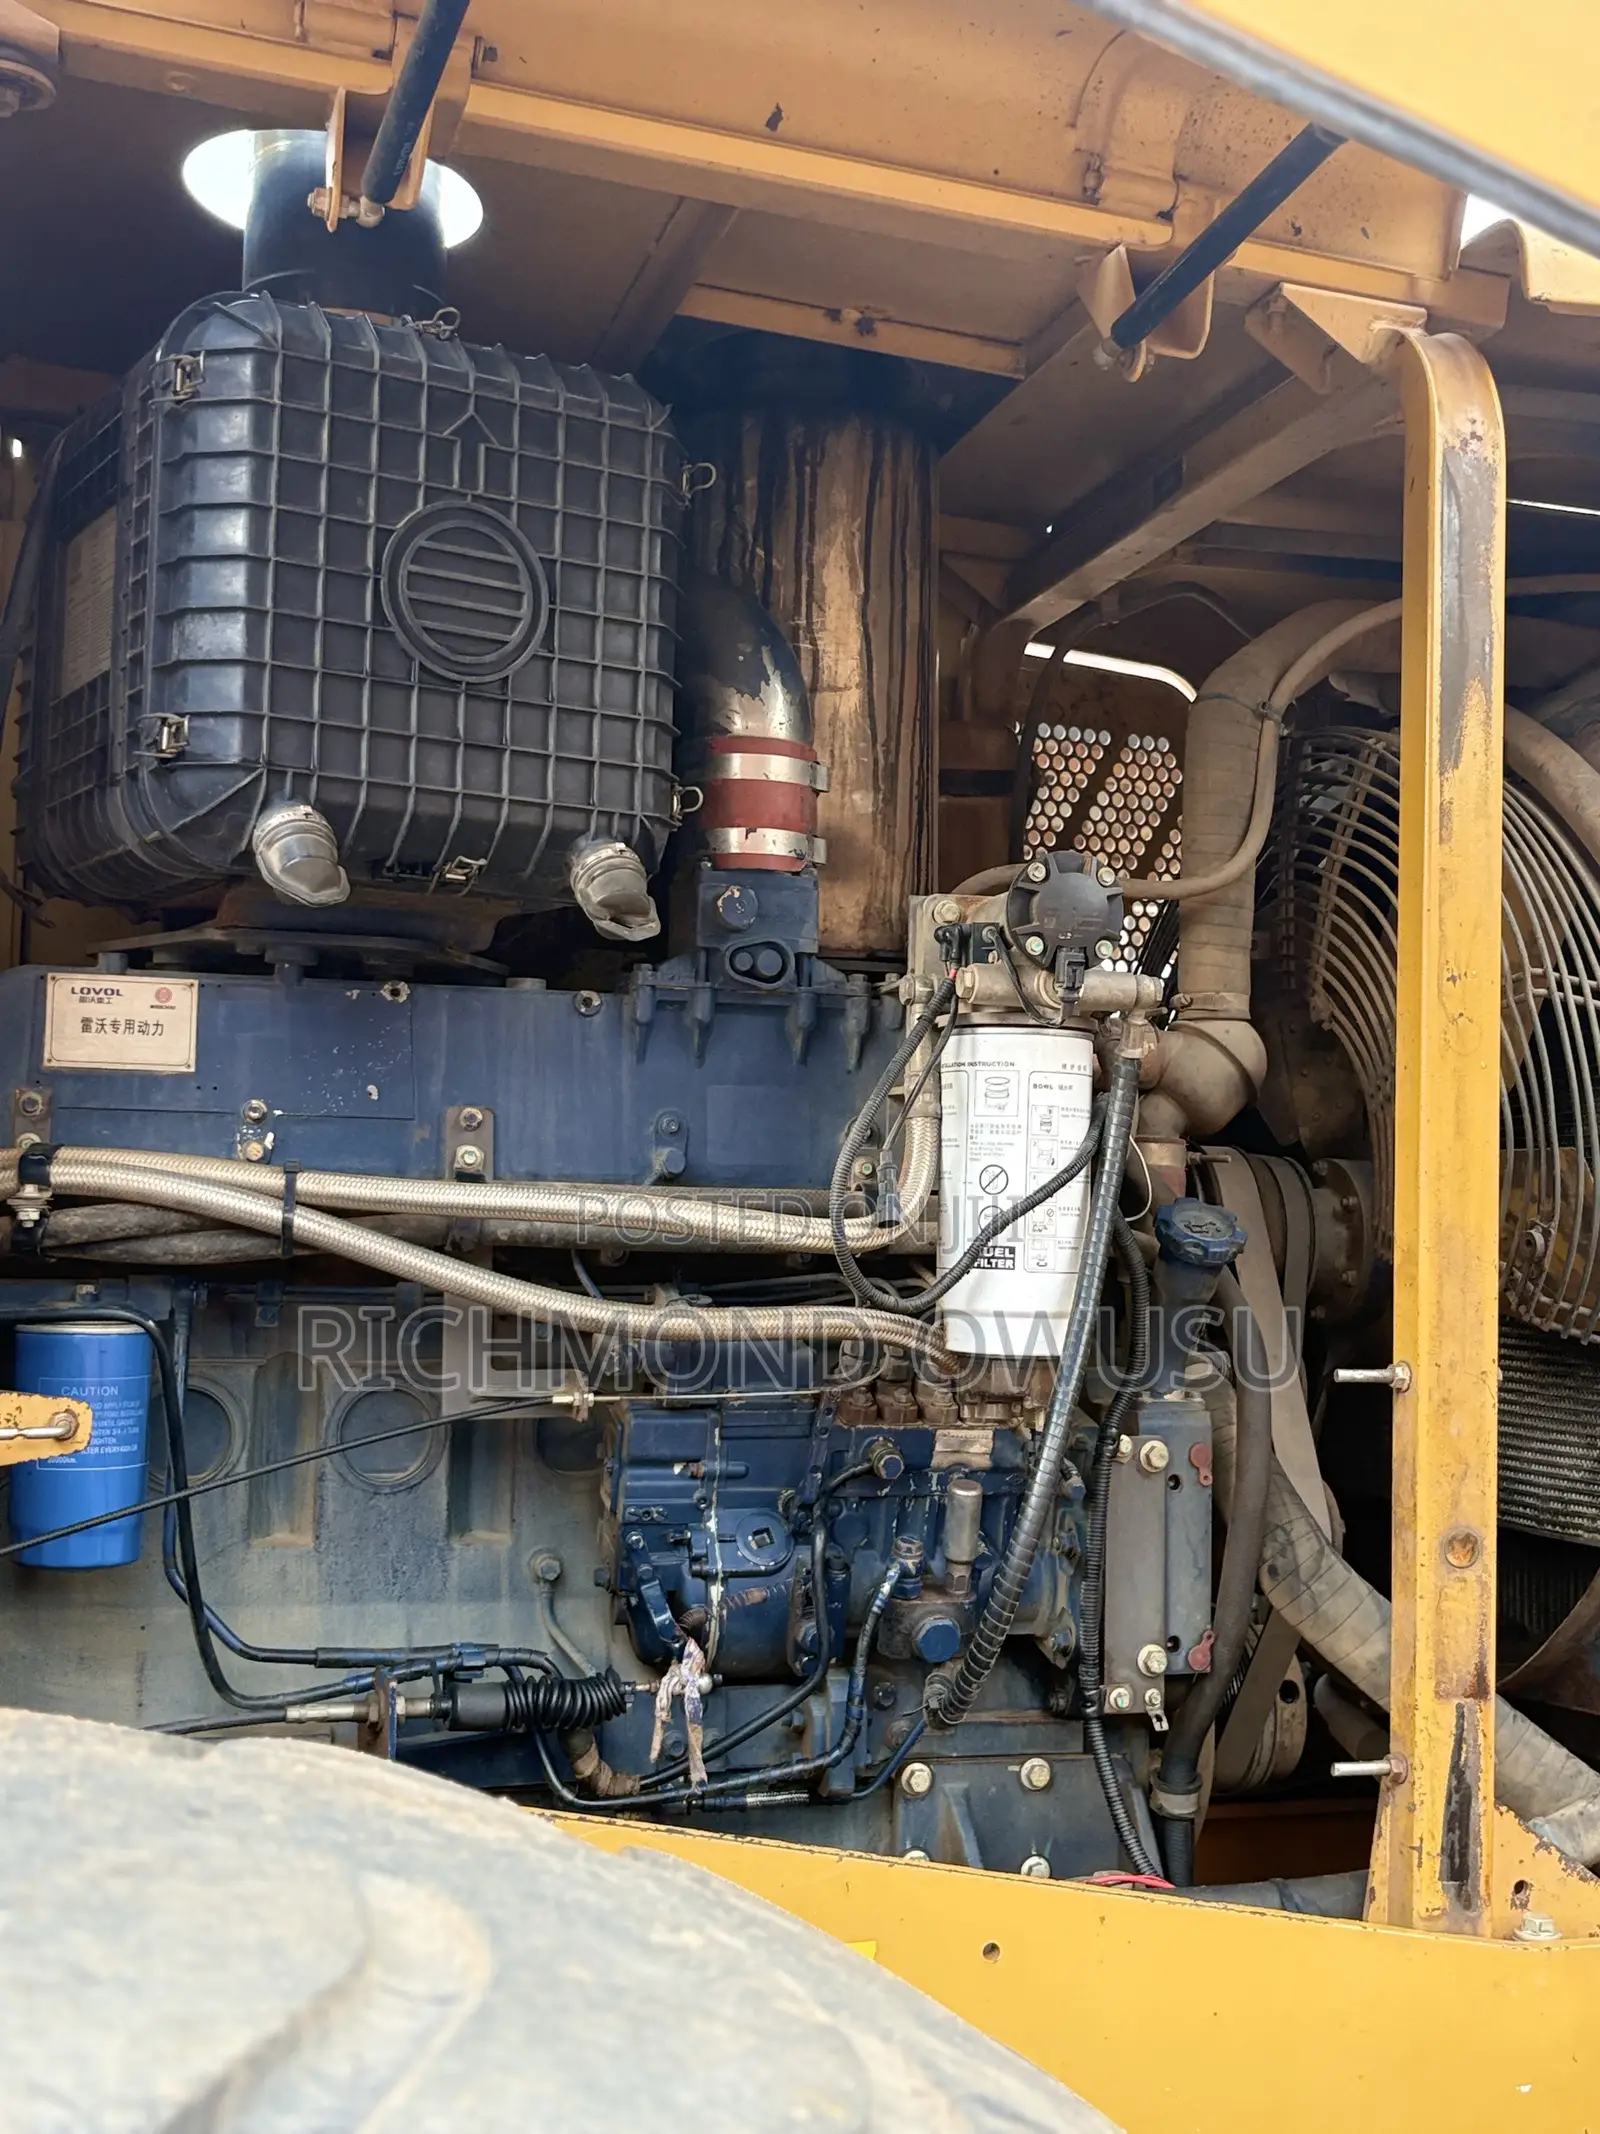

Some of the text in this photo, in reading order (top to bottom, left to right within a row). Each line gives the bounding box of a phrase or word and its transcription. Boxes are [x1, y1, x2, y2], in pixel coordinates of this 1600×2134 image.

[71, 986, 124, 997] LOVOL
[80, 1016, 164, 1036] 雷沃专用动力
[967, 1060, 1015, 1068] INSTRUCTION
[983, 1246, 1015, 1257] UEL
[61, 1385, 119, 1397] CAUTION
